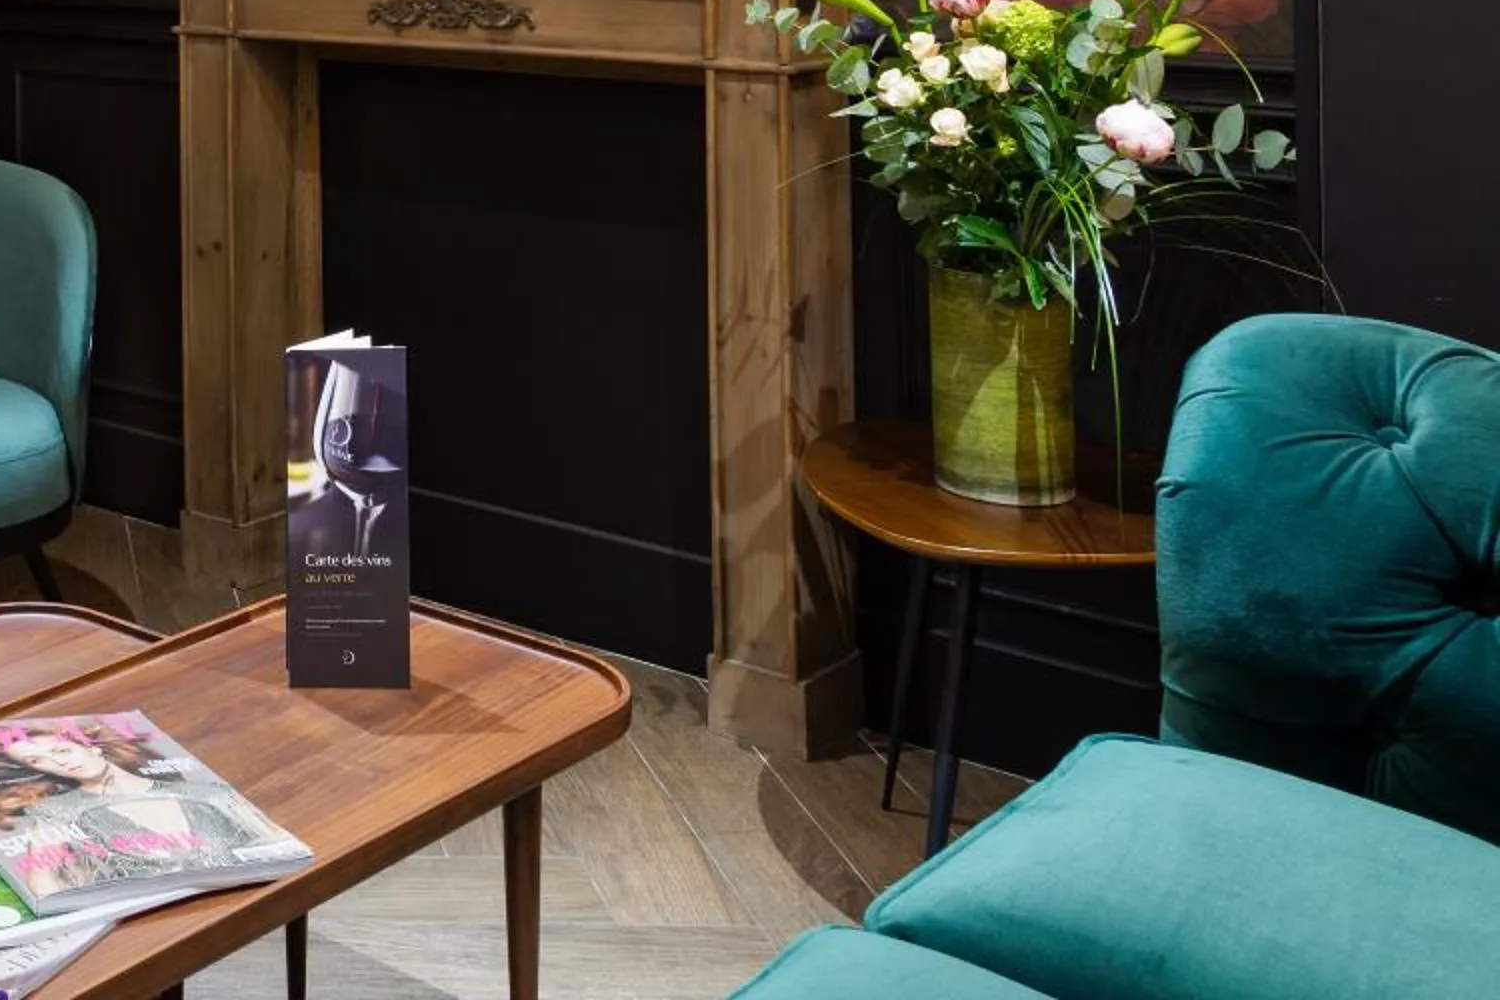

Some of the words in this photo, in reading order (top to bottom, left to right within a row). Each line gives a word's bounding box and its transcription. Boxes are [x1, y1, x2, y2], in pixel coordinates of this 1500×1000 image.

[304, 553, 340, 567] Carte
[341, 552, 365, 567] des
[366, 553, 392, 567] vins
[305, 573, 321, 584] au
[323, 573, 357, 584] verre
